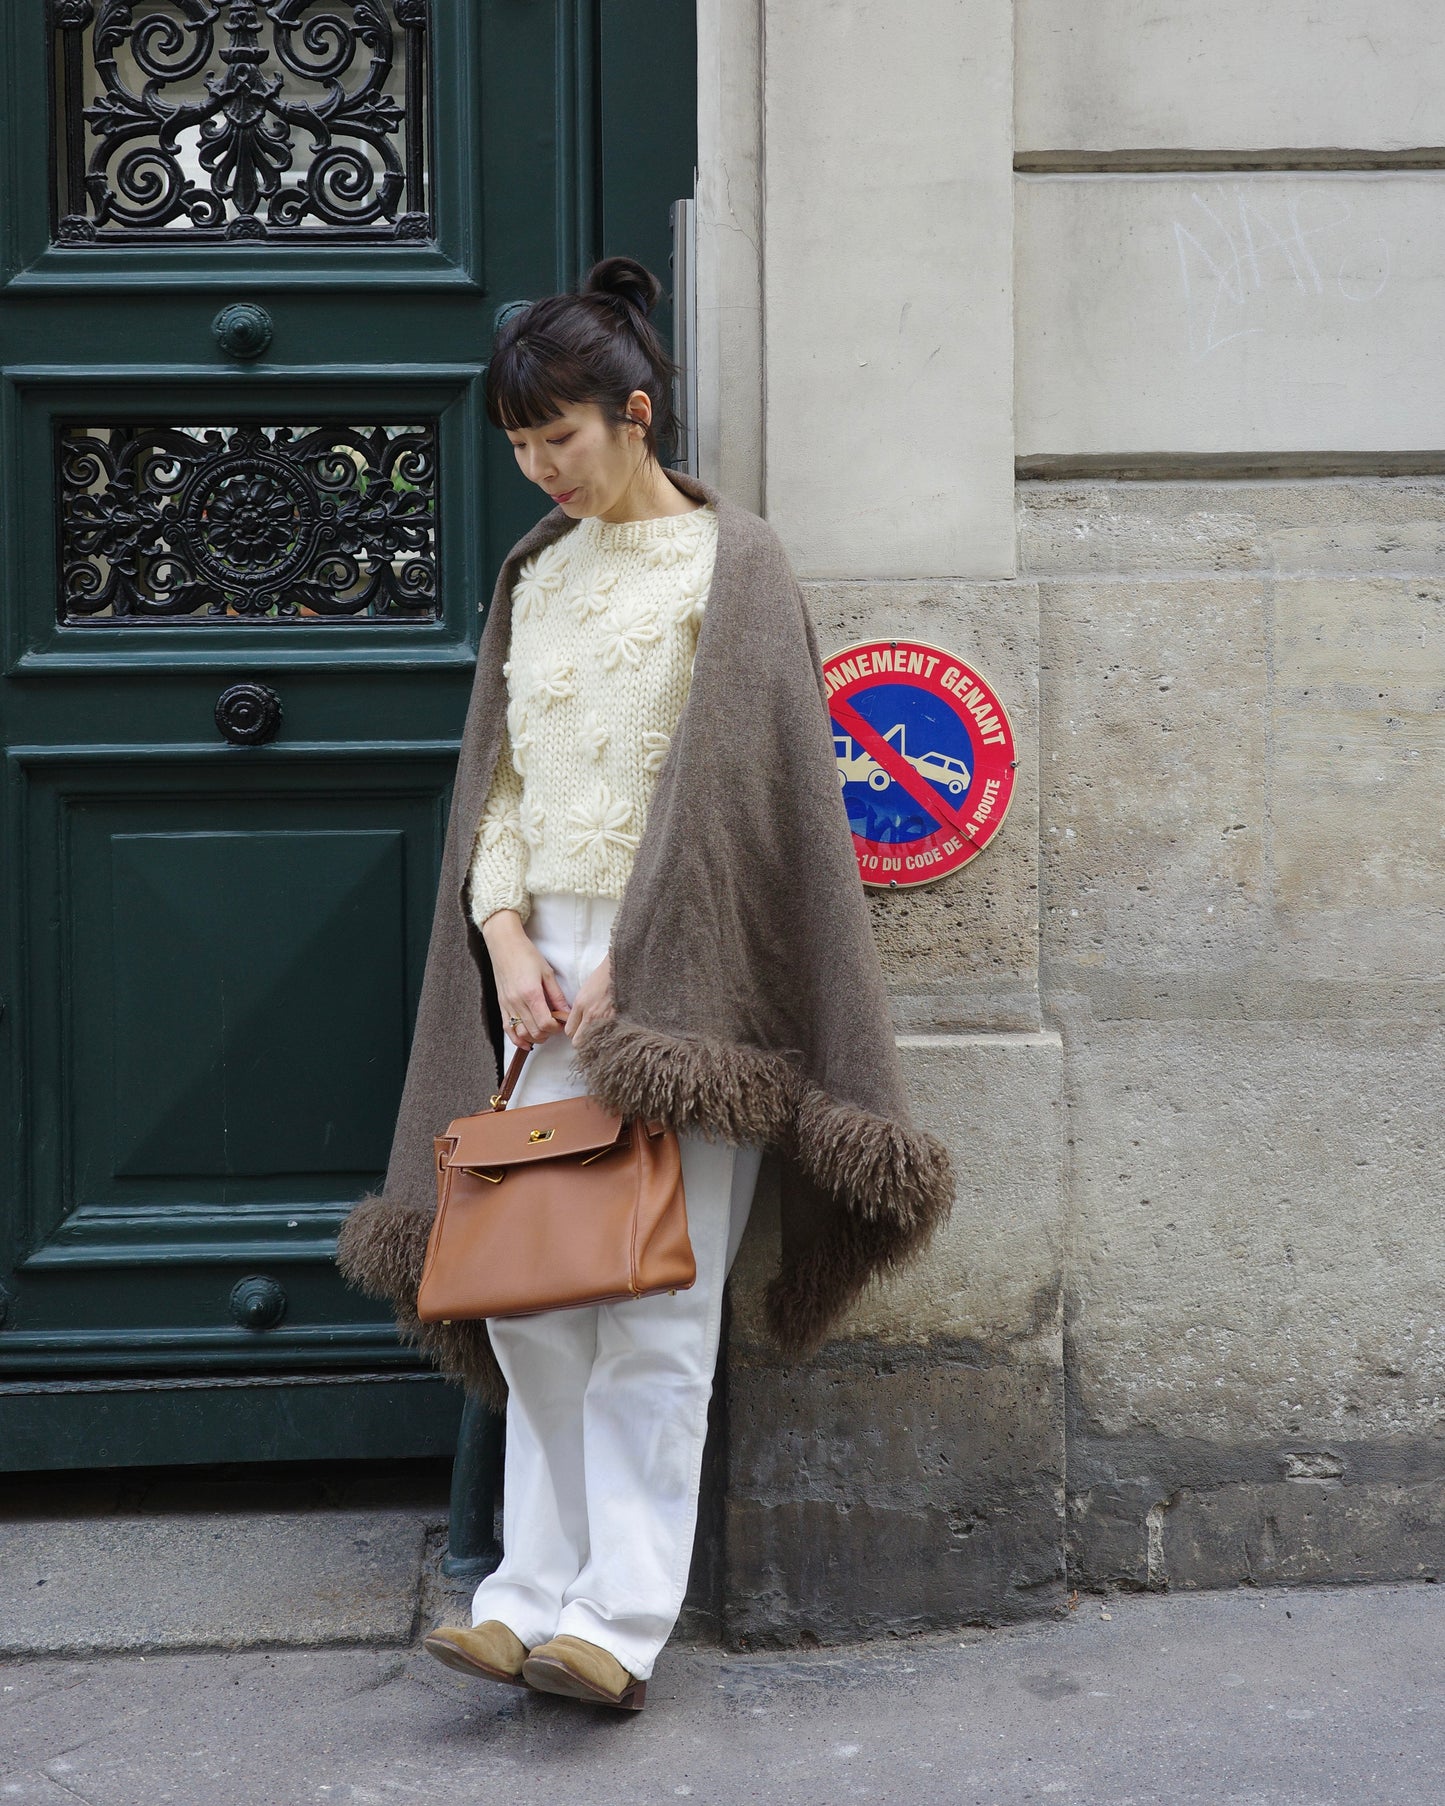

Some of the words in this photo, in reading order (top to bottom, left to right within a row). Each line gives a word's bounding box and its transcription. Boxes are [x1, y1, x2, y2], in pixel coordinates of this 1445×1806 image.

[940, 666, 1006, 745] GENANT
[882, 857, 901, 871] DU
[906, 846, 943, 870] CODE
[945, 836, 963, 855] DE
[975, 779, 1000, 823] ROUTE
